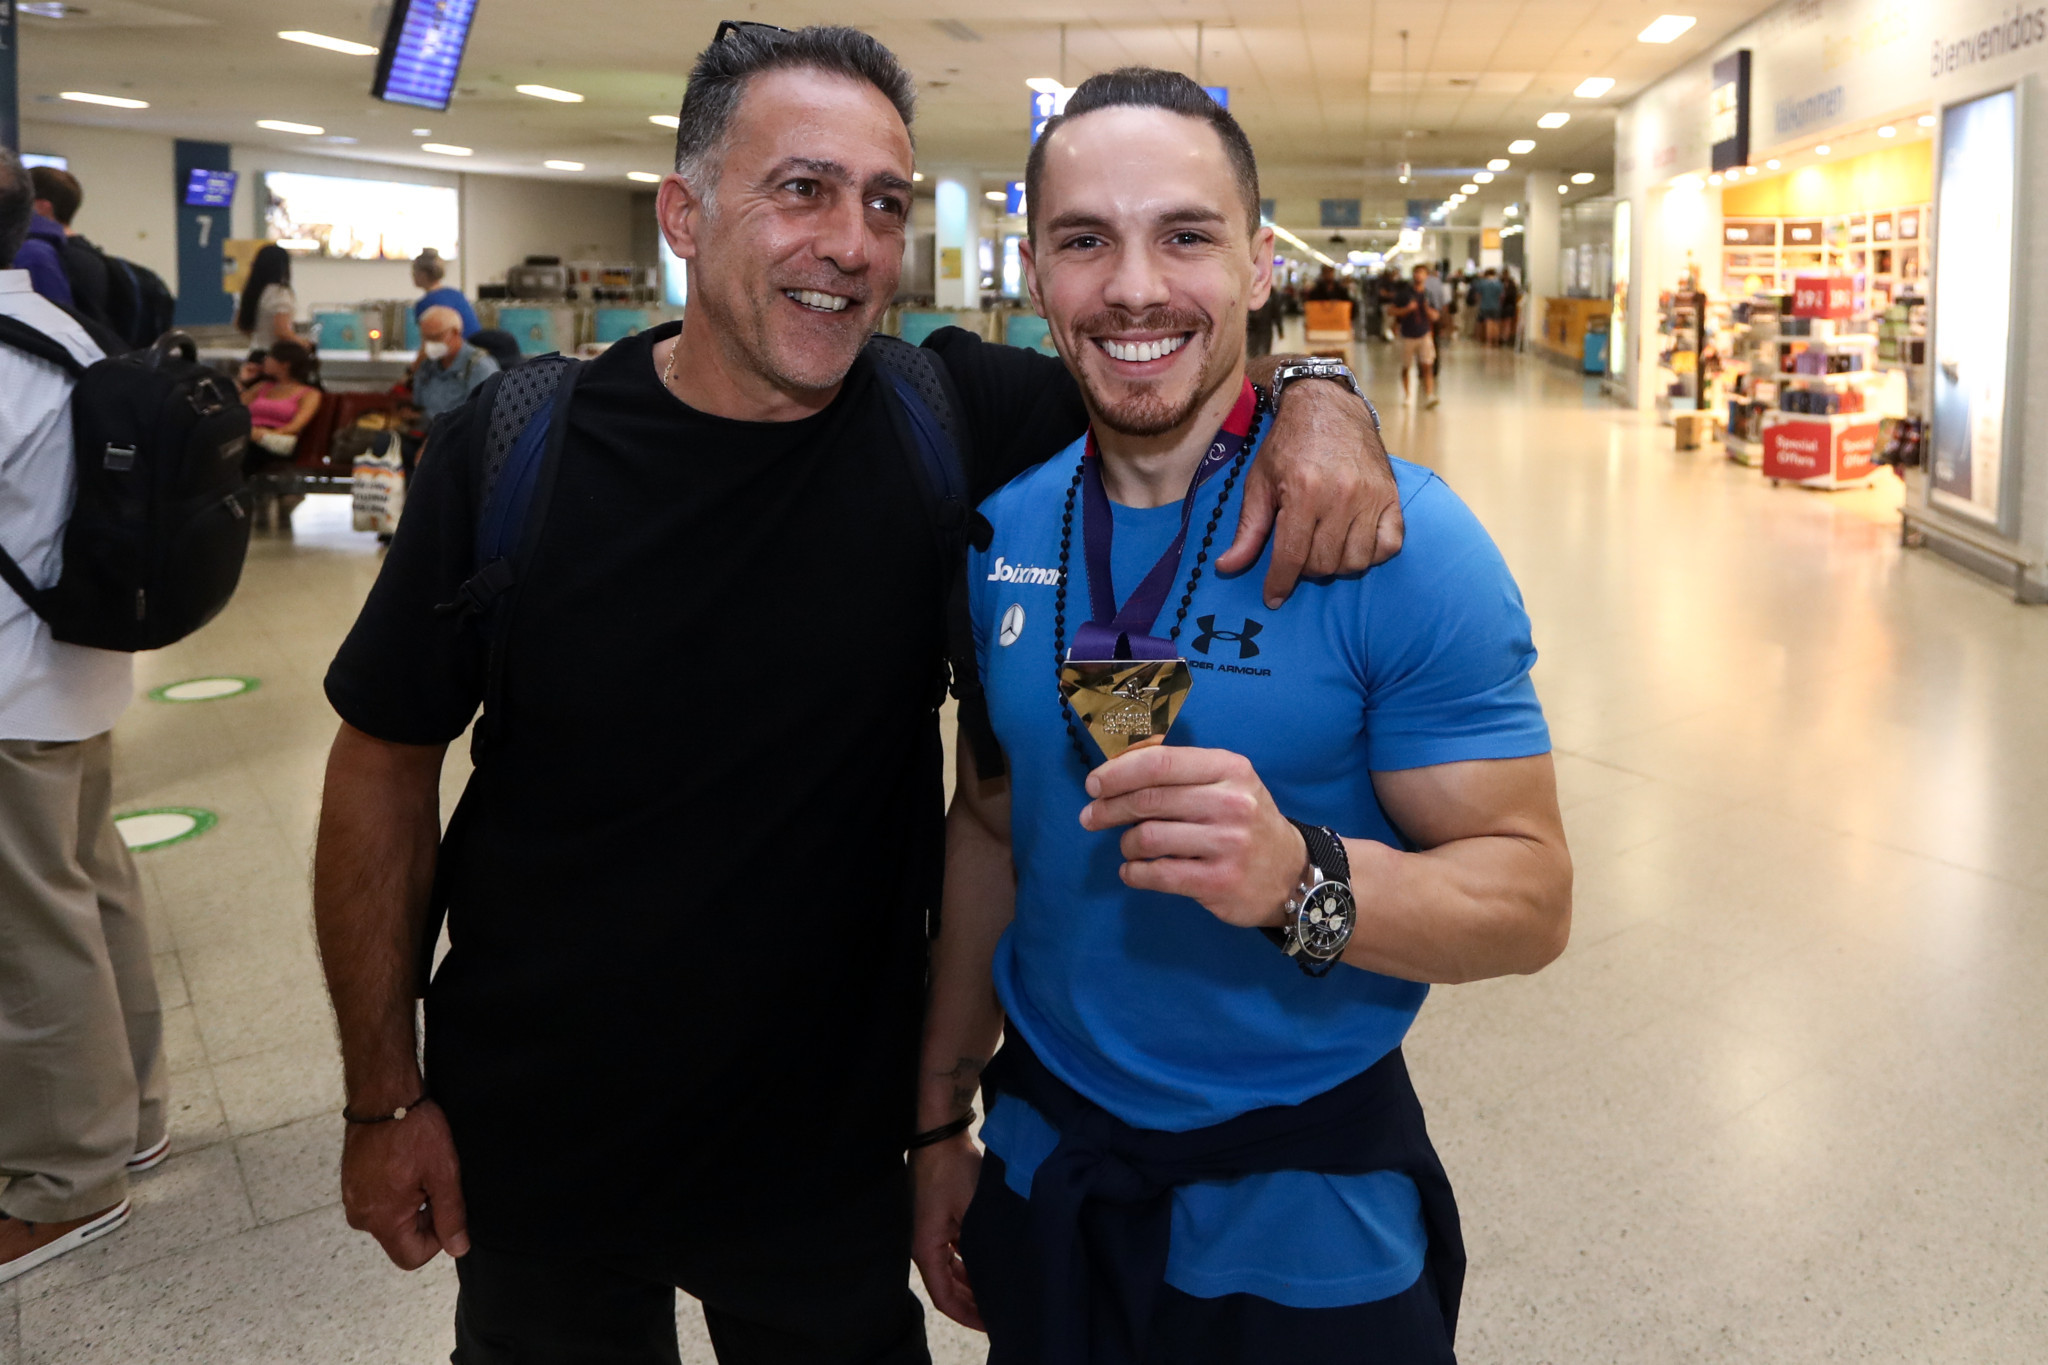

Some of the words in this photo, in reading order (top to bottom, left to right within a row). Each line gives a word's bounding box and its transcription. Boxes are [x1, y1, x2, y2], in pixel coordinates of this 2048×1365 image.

[196, 215, 213, 248] 7
[1775, 434, 1818, 453] Special
[1189, 660, 1214, 671] DER
[1217, 664, 1271, 677] ARMOUR
